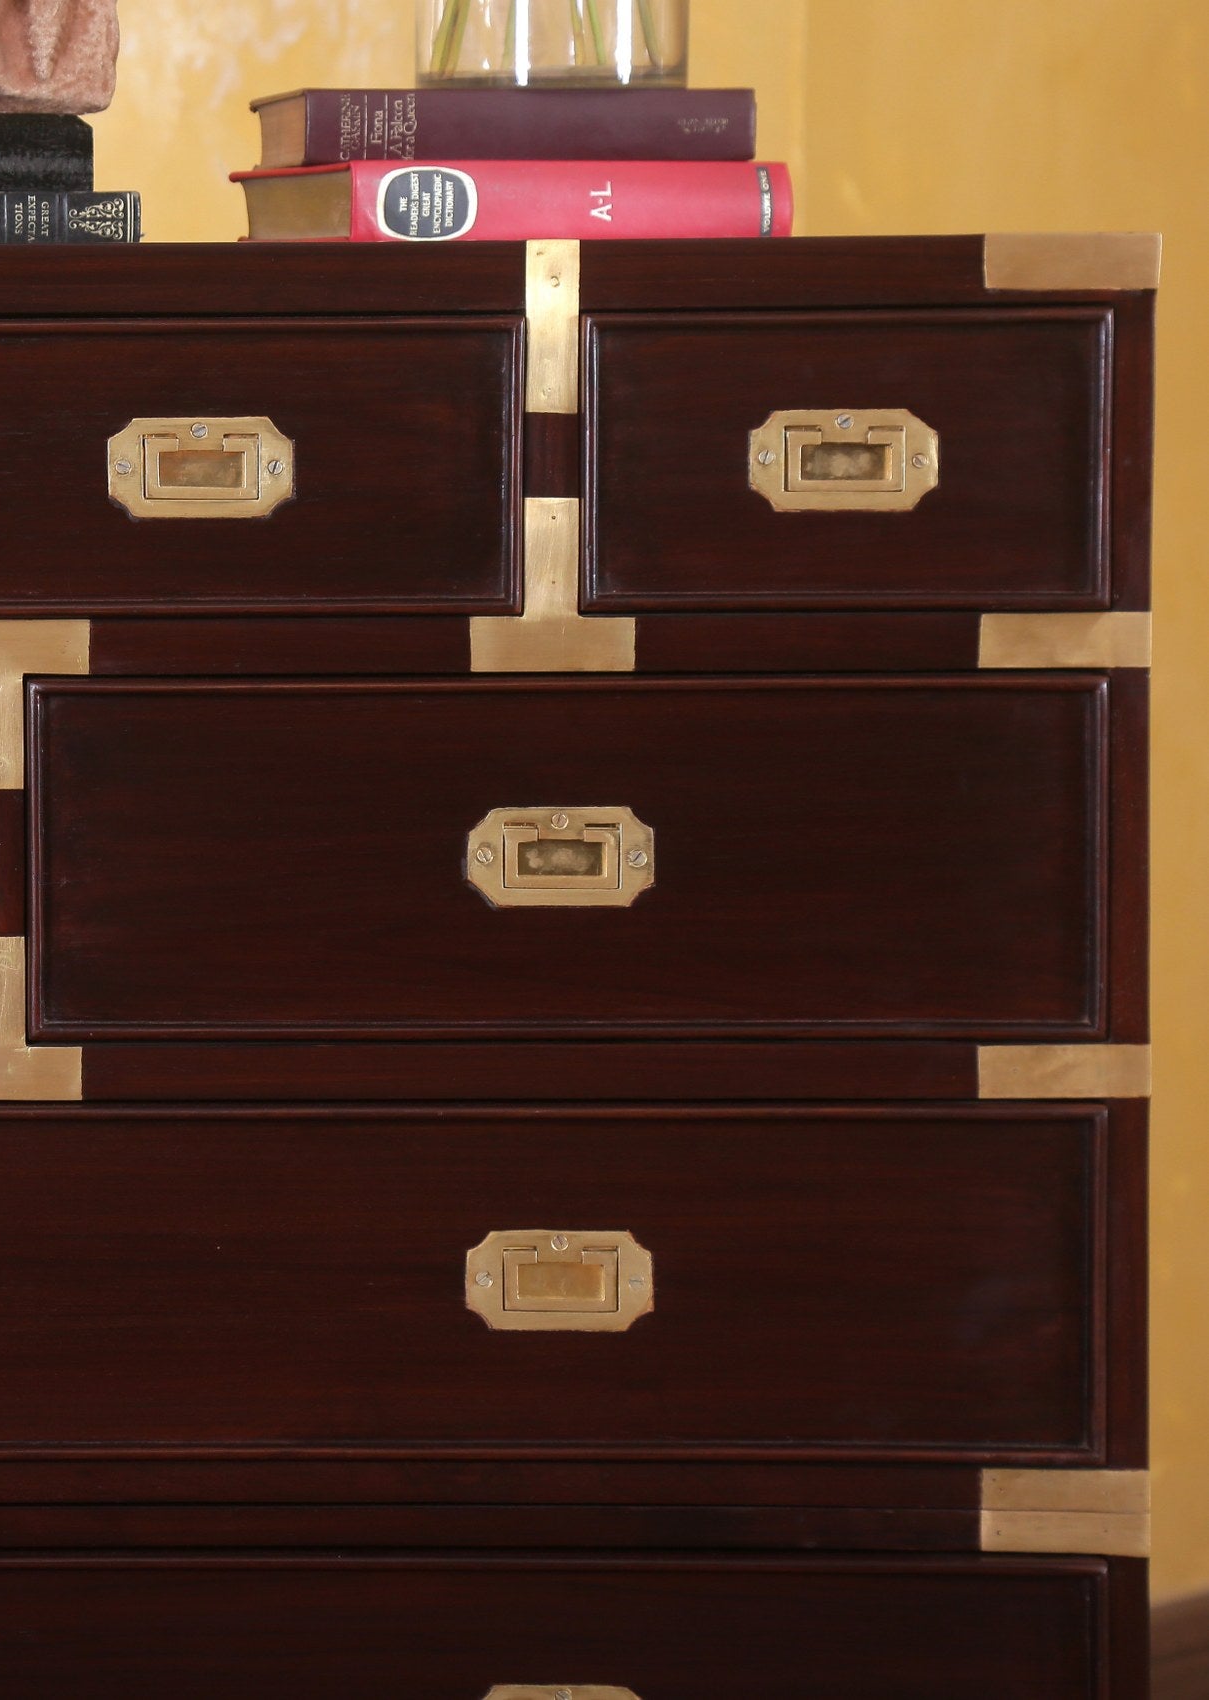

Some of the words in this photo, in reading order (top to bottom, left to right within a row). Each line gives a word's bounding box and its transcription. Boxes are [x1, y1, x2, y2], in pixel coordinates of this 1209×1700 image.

[371, 109, 384, 144] Fiona
[390, 99, 403, 139] Falcon
[403, 93, 418, 135] Queen
[390, 142, 403, 156] A
[401, 144, 416, 160] for
[410, 172, 420, 200] DIGEST
[759, 170, 770, 191] ONE
[14, 202, 24, 235] TIONS
[41, 201, 50, 237] GREAT
[399, 196, 408, 212] THE
[410, 201, 419, 236] READER'S
[422, 191, 431, 217] GREAT
[433, 173, 443, 234] ENCYCLOPAEDIC
[445, 181, 454, 227] DICTIONARY
